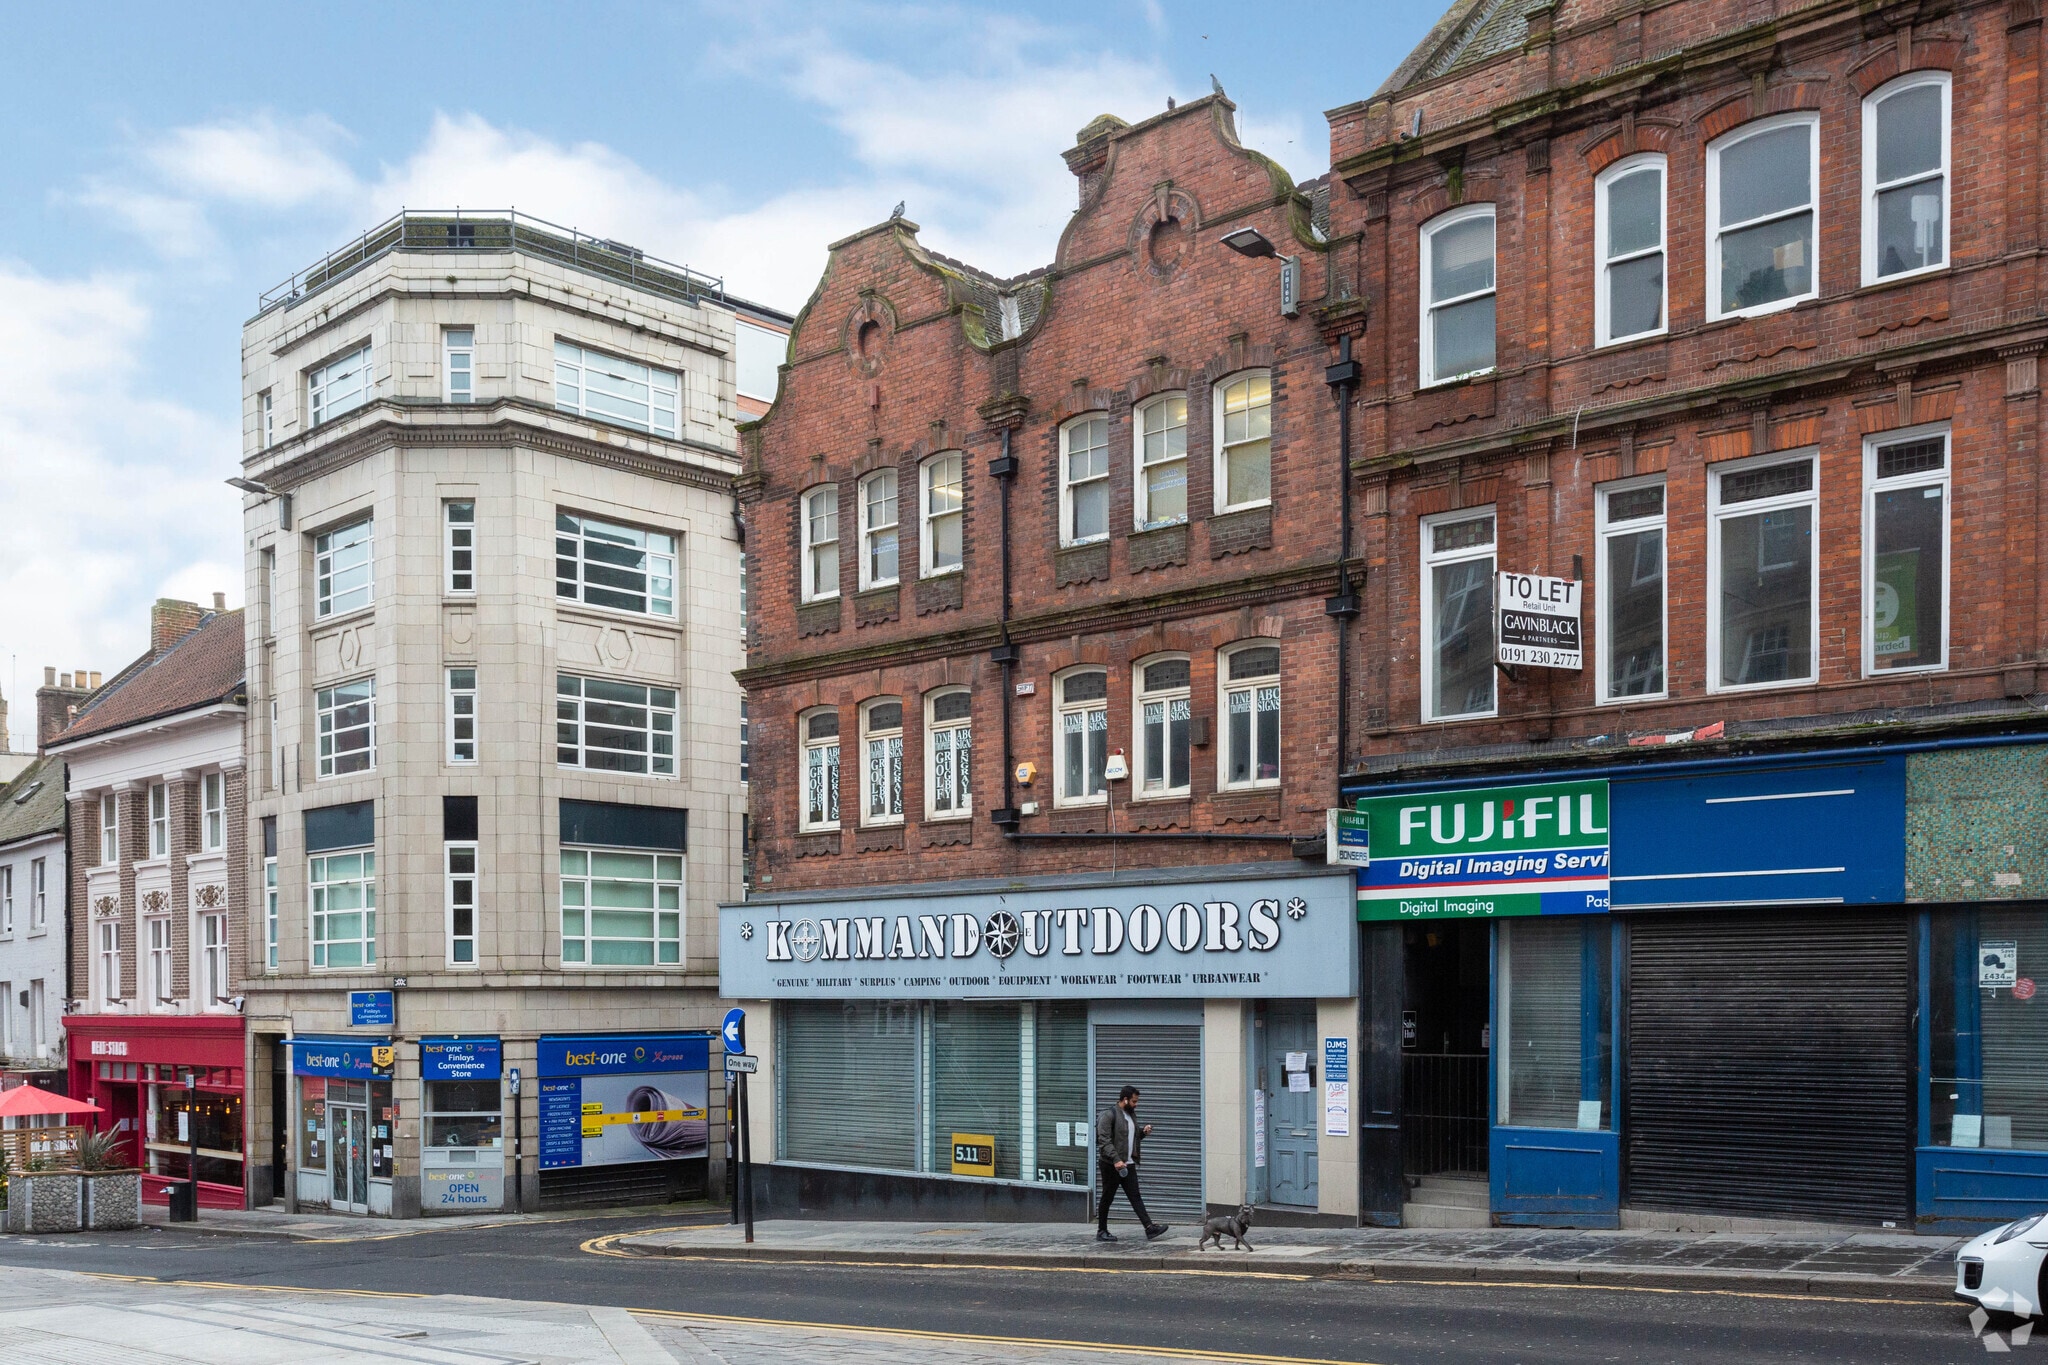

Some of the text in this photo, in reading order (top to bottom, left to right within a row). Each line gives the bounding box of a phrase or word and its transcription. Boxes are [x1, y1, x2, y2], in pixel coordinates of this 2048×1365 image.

[1506, 575, 1574, 604] TO LET
[1523, 601, 1556, 612] Retail Unit
[1528, 636, 1558, 644] PARTNERS
[1501, 647, 1579, 666] 0191 230 2777
[1231, 692, 1250, 704] TYNE
[1258, 688, 1280, 700] ABC
[1171, 700, 1190, 712] ABC
[1258, 700, 1280, 712] SIGNS
[1170, 710, 1190, 722] SIGNS
[936, 752, 944, 800] GOLF
[894, 758, 902, 814] ENGRAVING
[832, 766, 840, 820] ENGRAVING
[1400, 859, 1462, 880] Digital
[1466, 856, 1548, 876] Imaging
[1400, 898, 1494, 916] Digital Imaging
[1586, 895, 1608, 908] Pas
[776, 973, 1261, 988] GENUINE MILITARY SURPLUS CAMPING OUTDOOR EQUIPMENT WORKWEAR FOOTWEAR URBANWEAR
[1326, 1040, 1346, 1048] DJMS
[306, 1052, 340, 1068] best-one
[448, 1054, 474, 1062] Finlays
[566, 1050, 684, 1066] best-one Xpress
[728, 1058, 755, 1070] One way
[1328, 1084, 1346, 1092] ABC
[956, 1146, 978, 1162] 5.11
[428, 1172, 465, 1180] best-one
[1038, 1168, 1062, 1183] 5.11
[449, 1184, 479, 1192] OPEN
[442, 1194, 487, 1203] 24 hours
